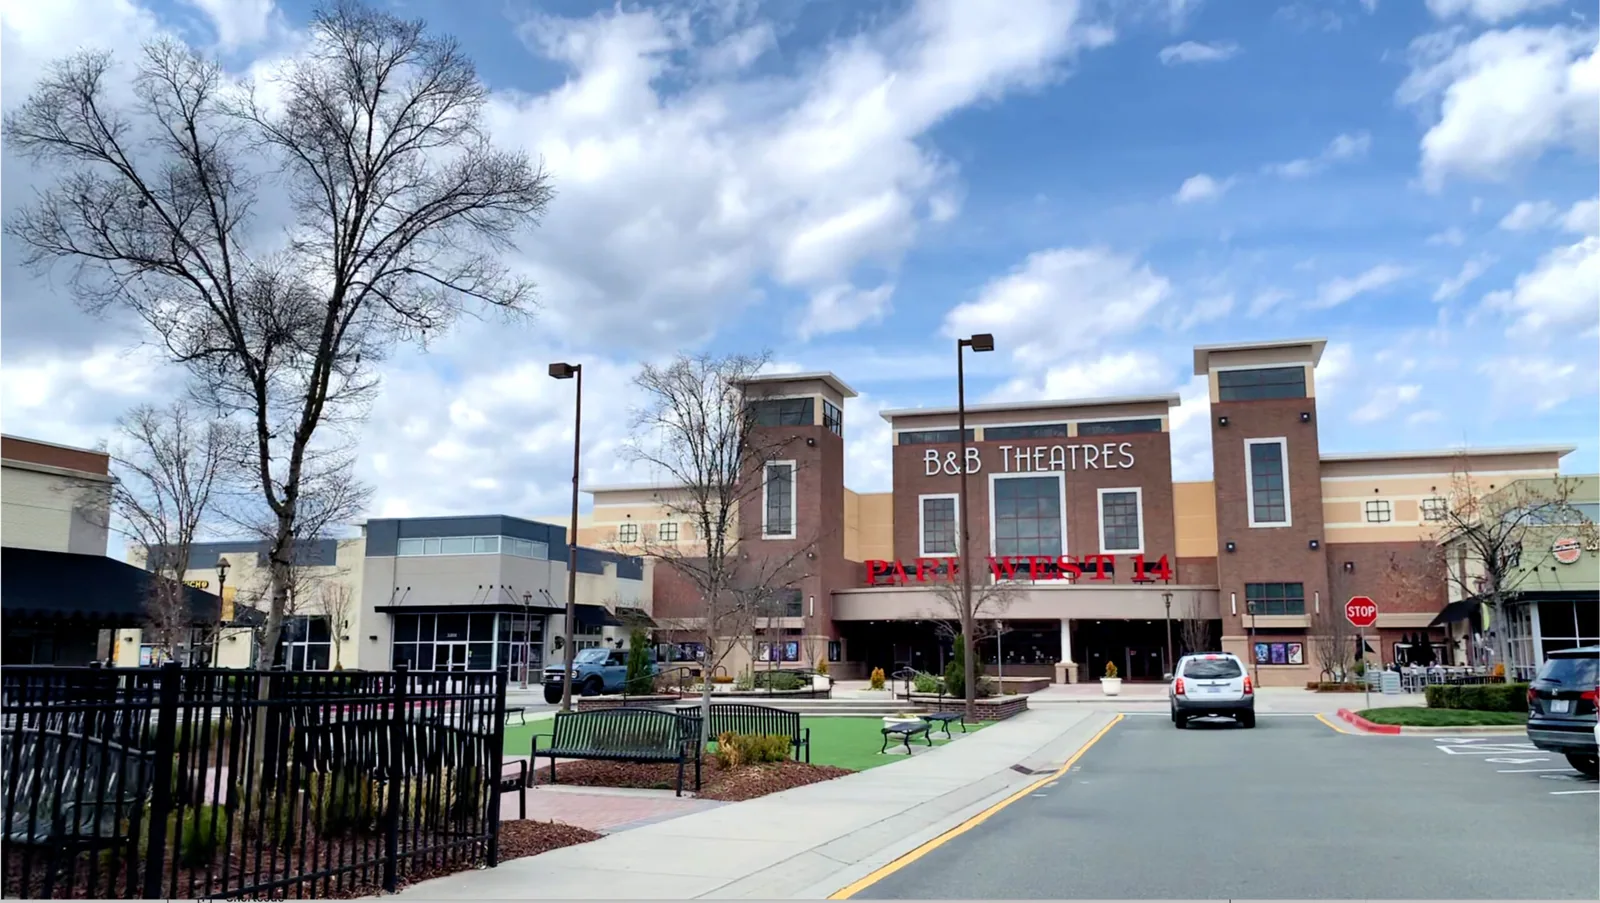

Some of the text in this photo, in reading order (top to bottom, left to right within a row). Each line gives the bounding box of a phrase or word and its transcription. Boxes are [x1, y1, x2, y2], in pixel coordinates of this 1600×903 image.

[923, 442, 1135, 476] B&B THEATRES
[984, 555, 1114, 582] WEST
[1130, 554, 1172, 582] 14
[1348, 605, 1375, 618] STOP
